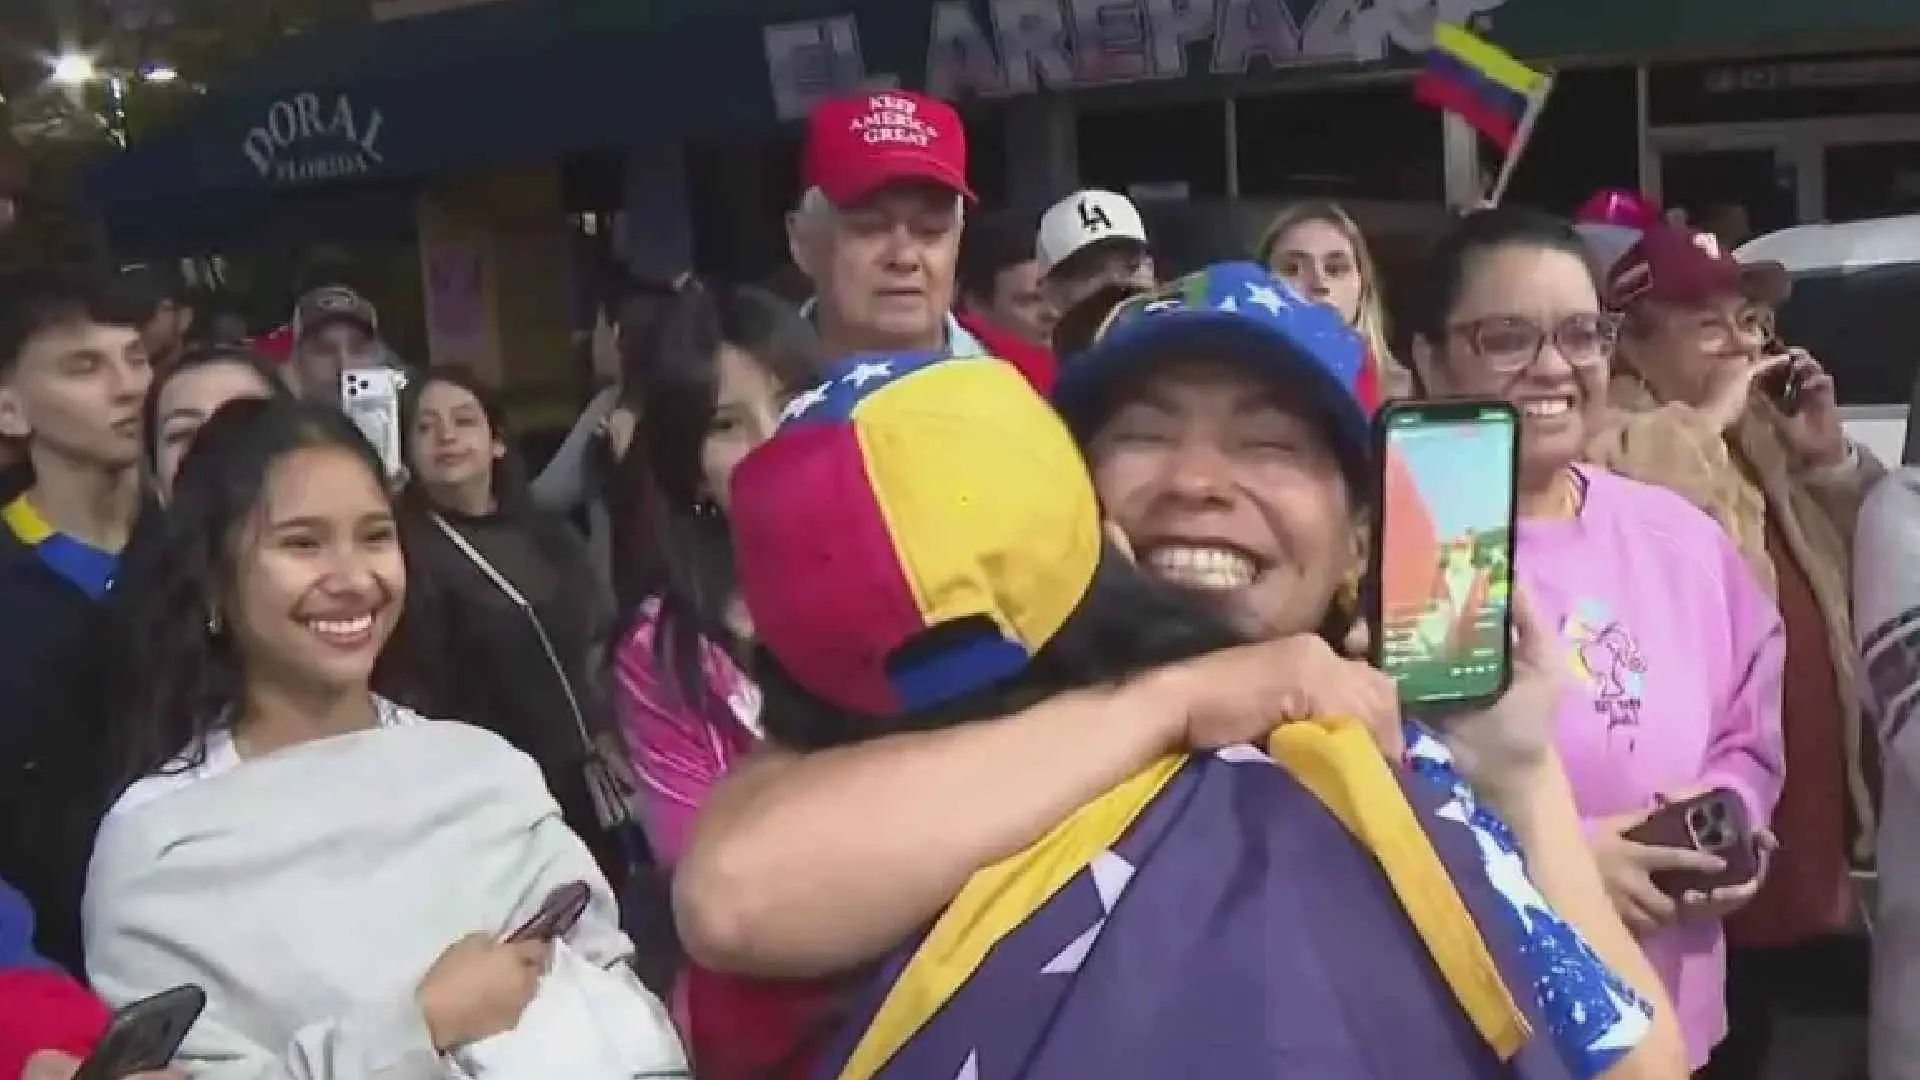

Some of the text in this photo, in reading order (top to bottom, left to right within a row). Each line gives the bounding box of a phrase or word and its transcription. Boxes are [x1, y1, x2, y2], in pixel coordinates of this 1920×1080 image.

[868, 96, 916, 113] KEEP
[243, 92, 384, 178] DORAL
[863, 127, 928, 147] GREAT
[274, 151, 368, 182] FLORIDA
[1078, 198, 1112, 232] LA
